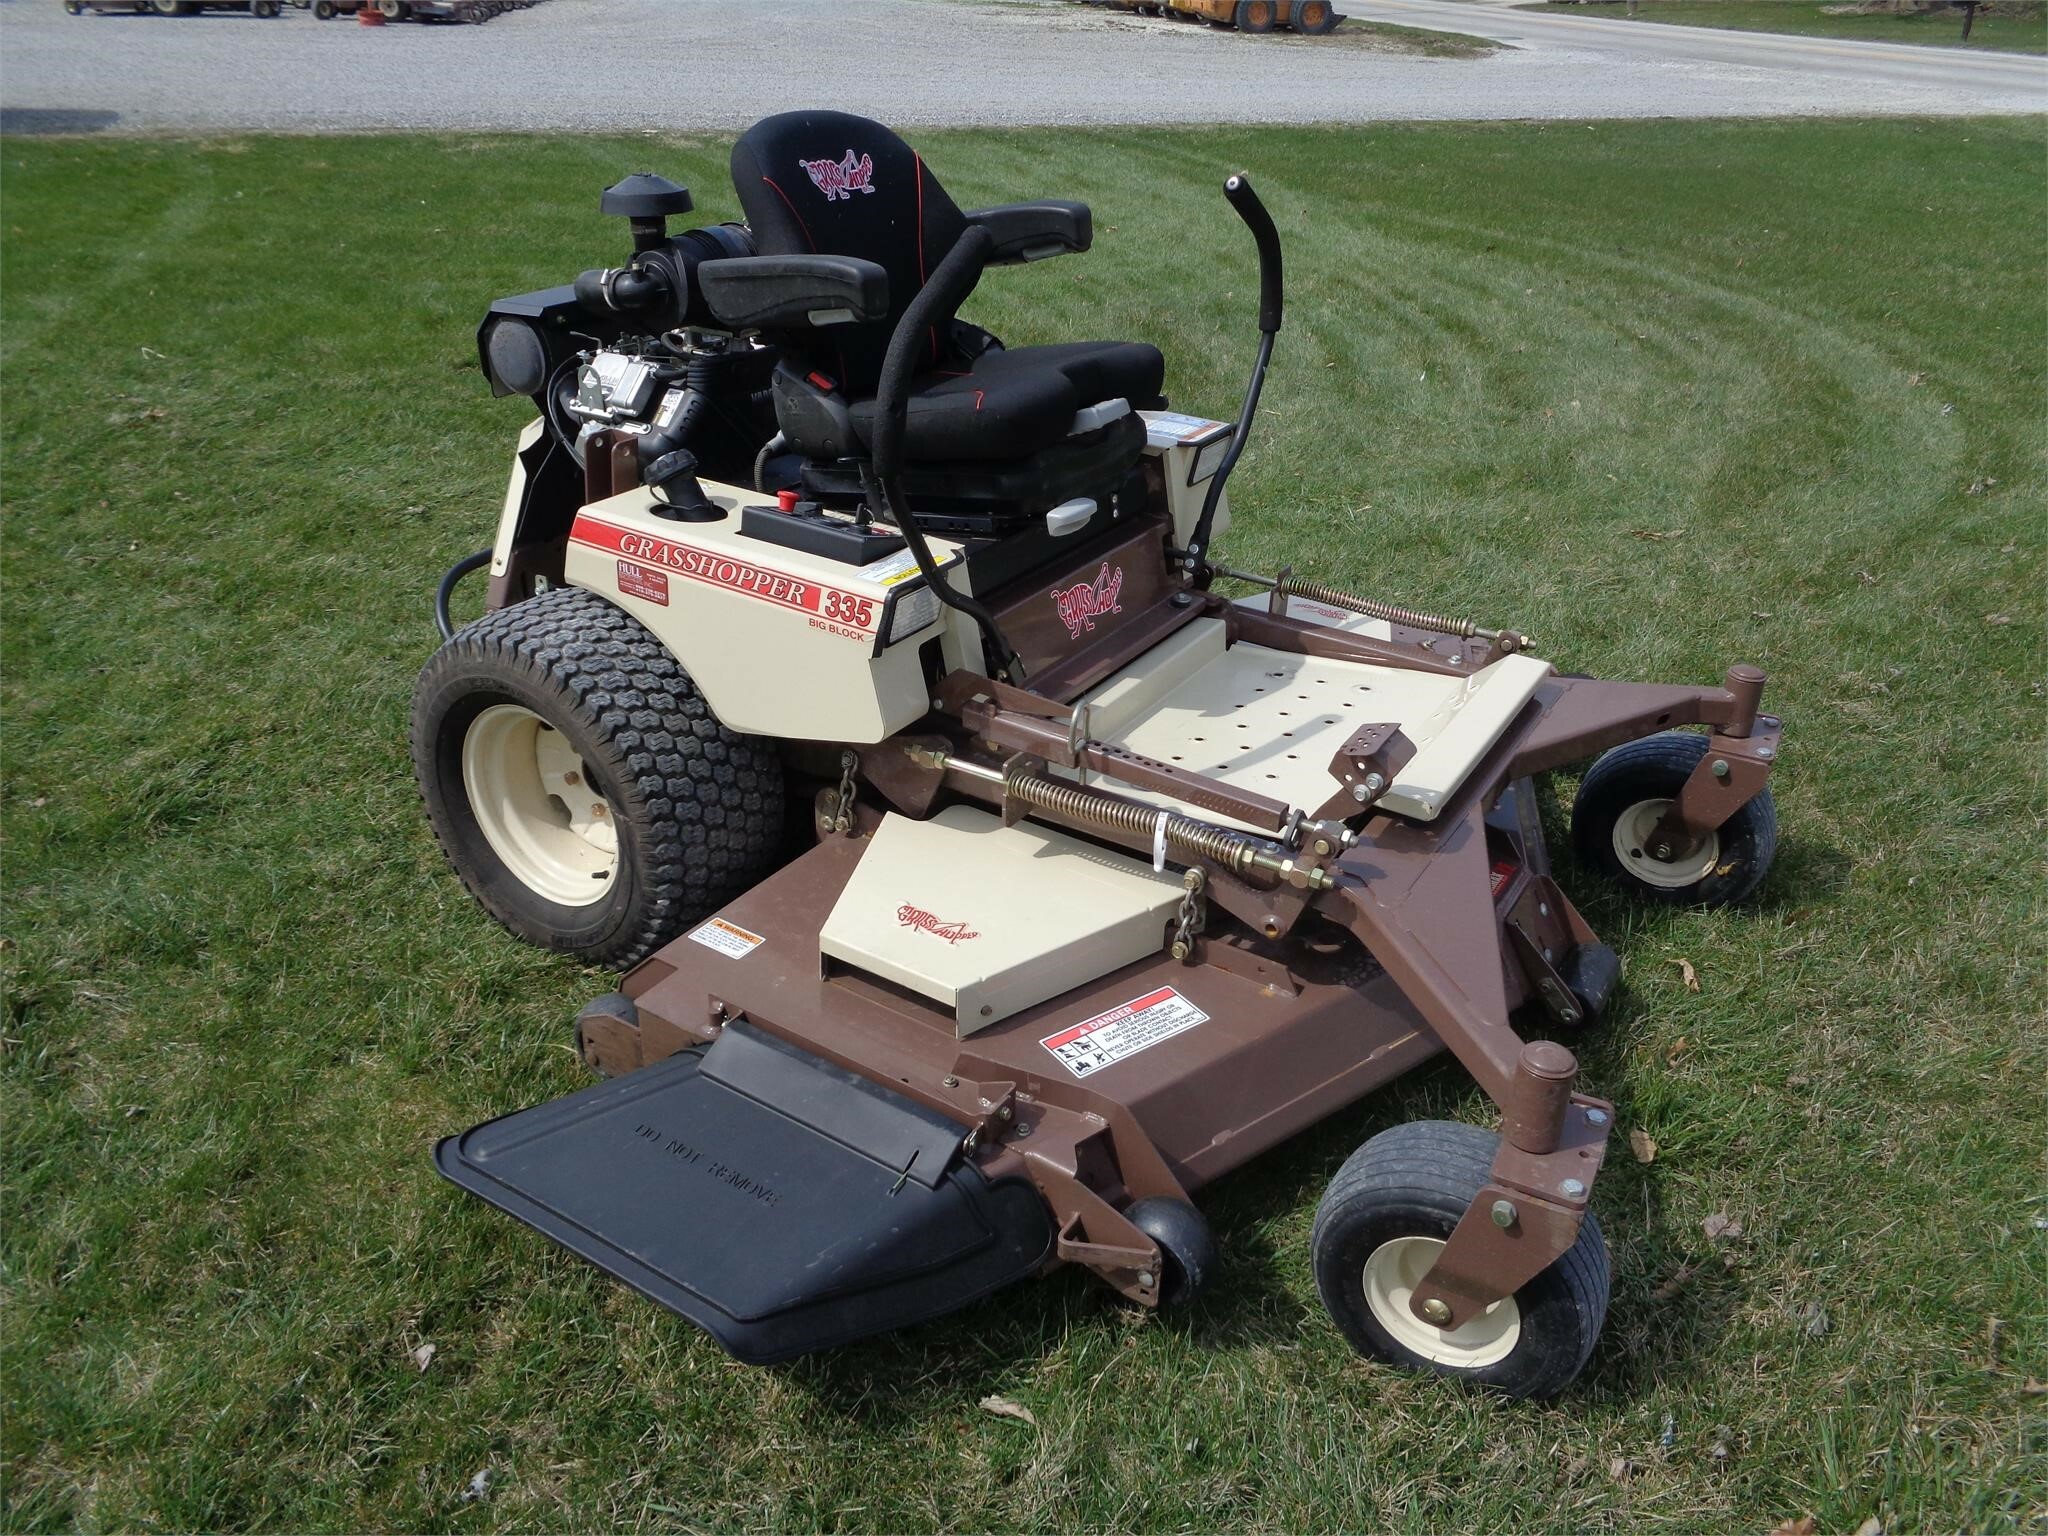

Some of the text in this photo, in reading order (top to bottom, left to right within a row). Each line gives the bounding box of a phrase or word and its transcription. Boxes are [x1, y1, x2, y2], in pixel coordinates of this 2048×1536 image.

[618, 561, 642, 578] HULL
[619, 533, 806, 605] GRASSHOPPER
[825, 591, 873, 627] 335
[809, 618, 864, 641] BIG BLOCK
[1088, 1006, 1135, 1029] DANGER
[1115, 1017, 1131, 1026] KEEP
[635, 1124, 661, 1142] DO
[665, 1139, 704, 1164] NOT
